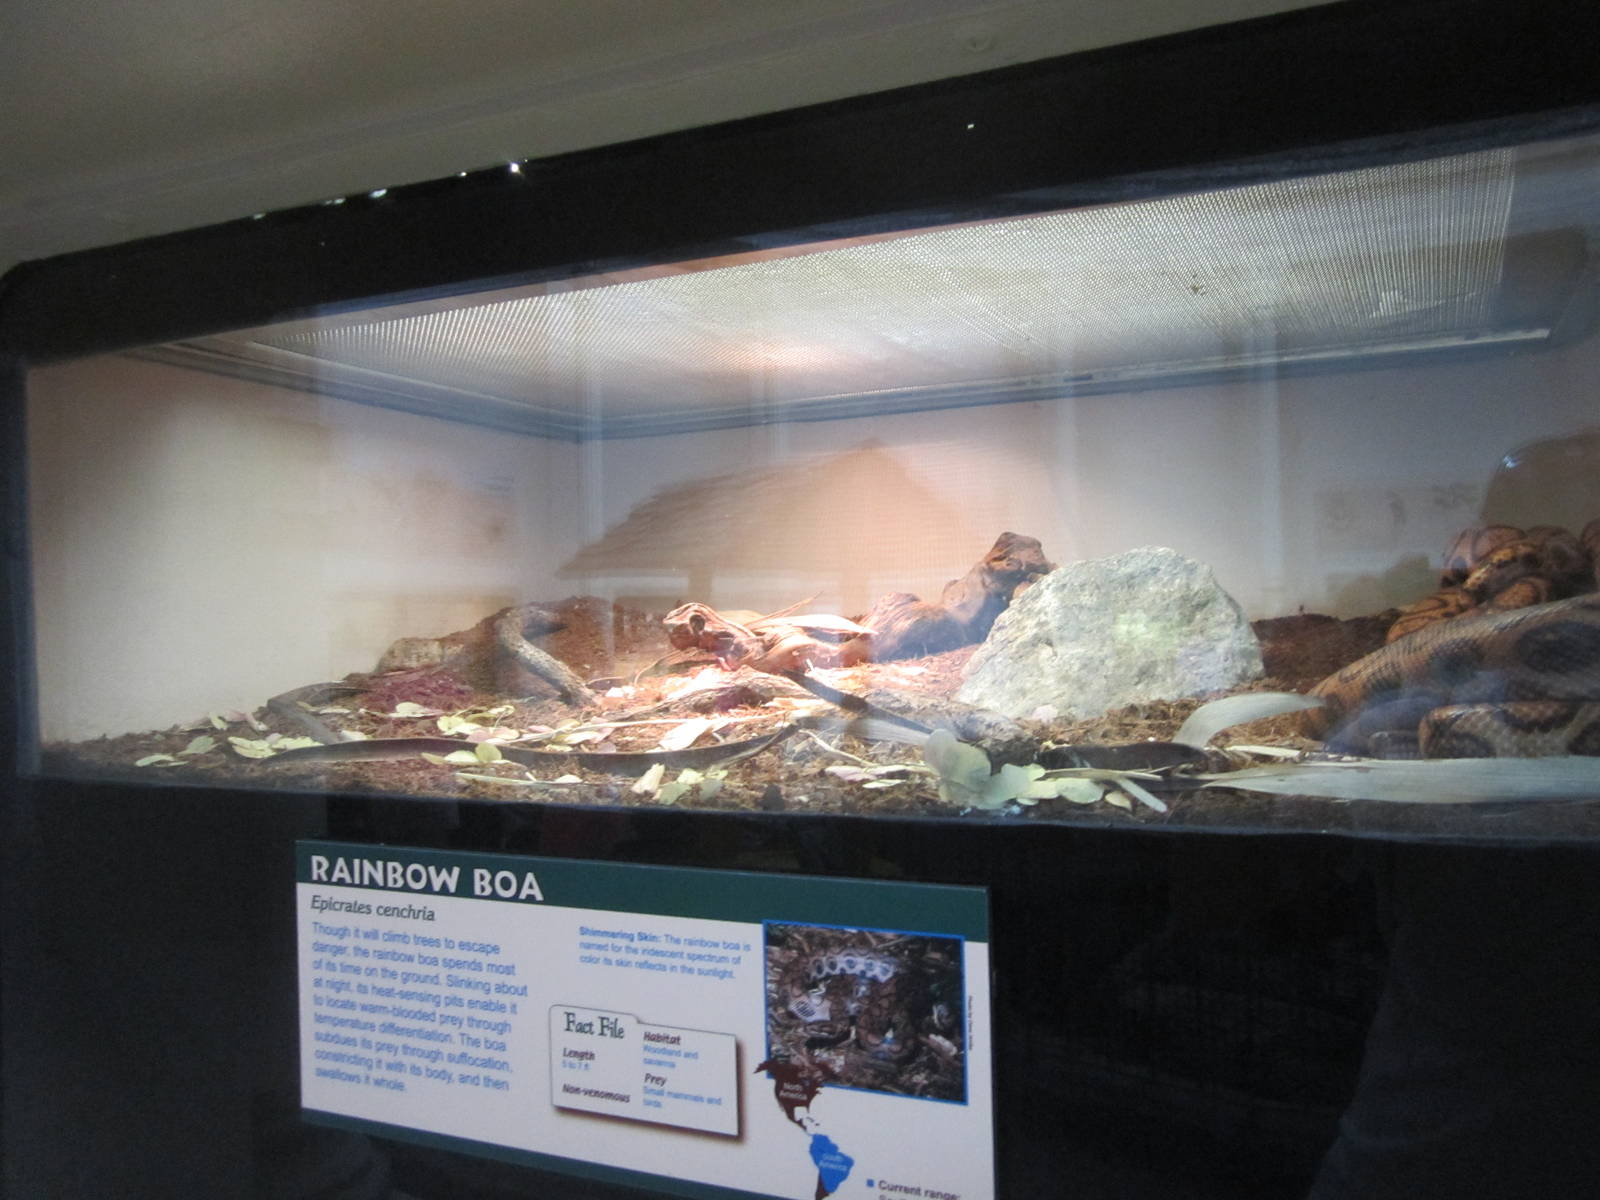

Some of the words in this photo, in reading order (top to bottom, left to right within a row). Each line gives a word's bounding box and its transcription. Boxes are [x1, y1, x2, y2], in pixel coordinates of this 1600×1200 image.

[310, 855, 460, 893] RAINBOW
[474, 868, 544, 901] BOA
[311, 895, 372, 914] Epicrates
[376, 905, 435, 921] cenchria
[312, 921, 350, 940] Though
[353, 927, 360, 938] it
[363, 928, 379, 940] will
[382, 930, 411, 944] climb
[413, 933, 441, 948] trees
[444, 938, 455, 949] to
[458, 940, 500, 956] escape
[579, 926, 634, 942] Shimmering
[663, 933, 681, 945] The
[683, 937, 720, 948] rainbow
[722, 940, 740, 951] boa
[353, 945, 370, 958] the
[373, 949, 416, 963] rainbow
[418, 953, 439, 966] boa
[442, 957, 483, 972] spends
[487, 963, 515, 976] most
[579, 942, 609, 952] named
[611, 943, 623, 953] for
[625, 945, 639, 955] the
[687, 952, 730, 964] spectrum
[732, 955, 742, 965] of
[579, 955, 600, 964] color
[615, 958, 632, 968] skin
[669, 964, 678, 973] in
[680, 964, 695, 975] the
[312, 959, 323, 969] of
[325, 961, 337, 972] its
[340, 962, 362, 975] time
[364, 967, 378, 977] on
[381, 967, 398, 979] the
[446, 974, 491, 995] Slinking
[494, 982, 528, 997] about
[313, 977, 322, 988] at
[356, 983, 369, 995] its
[371, 985, 440, 1008] heat-sensing
[444, 995, 464, 1007] pits
[467, 998, 507, 1013] enable
[510, 1002, 518, 1015] it
[313, 994, 324, 1006] to
[326, 996, 357, 1010] locate
[360, 1002, 436, 1022] warm-blooded
[439, 1013, 464, 1029] prey
[467, 1016, 512, 1035] through
[564, 1011, 594, 1035] Fact
[598, 1014, 625, 1039] File
[314, 1012, 376, 1032] temperature
[459, 1032, 481, 1048] The
[484, 1037, 507, 1052] boa
[643, 1030, 681, 1046] Habitat
[315, 1031, 357, 1047] subdues
[361, 1037, 373, 1049] its
[375, 1041, 399, 1057] prey
[402, 1044, 444, 1063] through
[562, 1047, 596, 1062] Length
[315, 1067, 361, 1084] swallows
[385, 1060, 407, 1073] with
[410, 1063, 422, 1076] its
[459, 1073, 480, 1086] and
[483, 1075, 509, 1091] then
[644, 1072, 667, 1087] Prey
[562, 1083, 631, 1103] Non-venomous
[878, 1180, 922, 1197] Current
